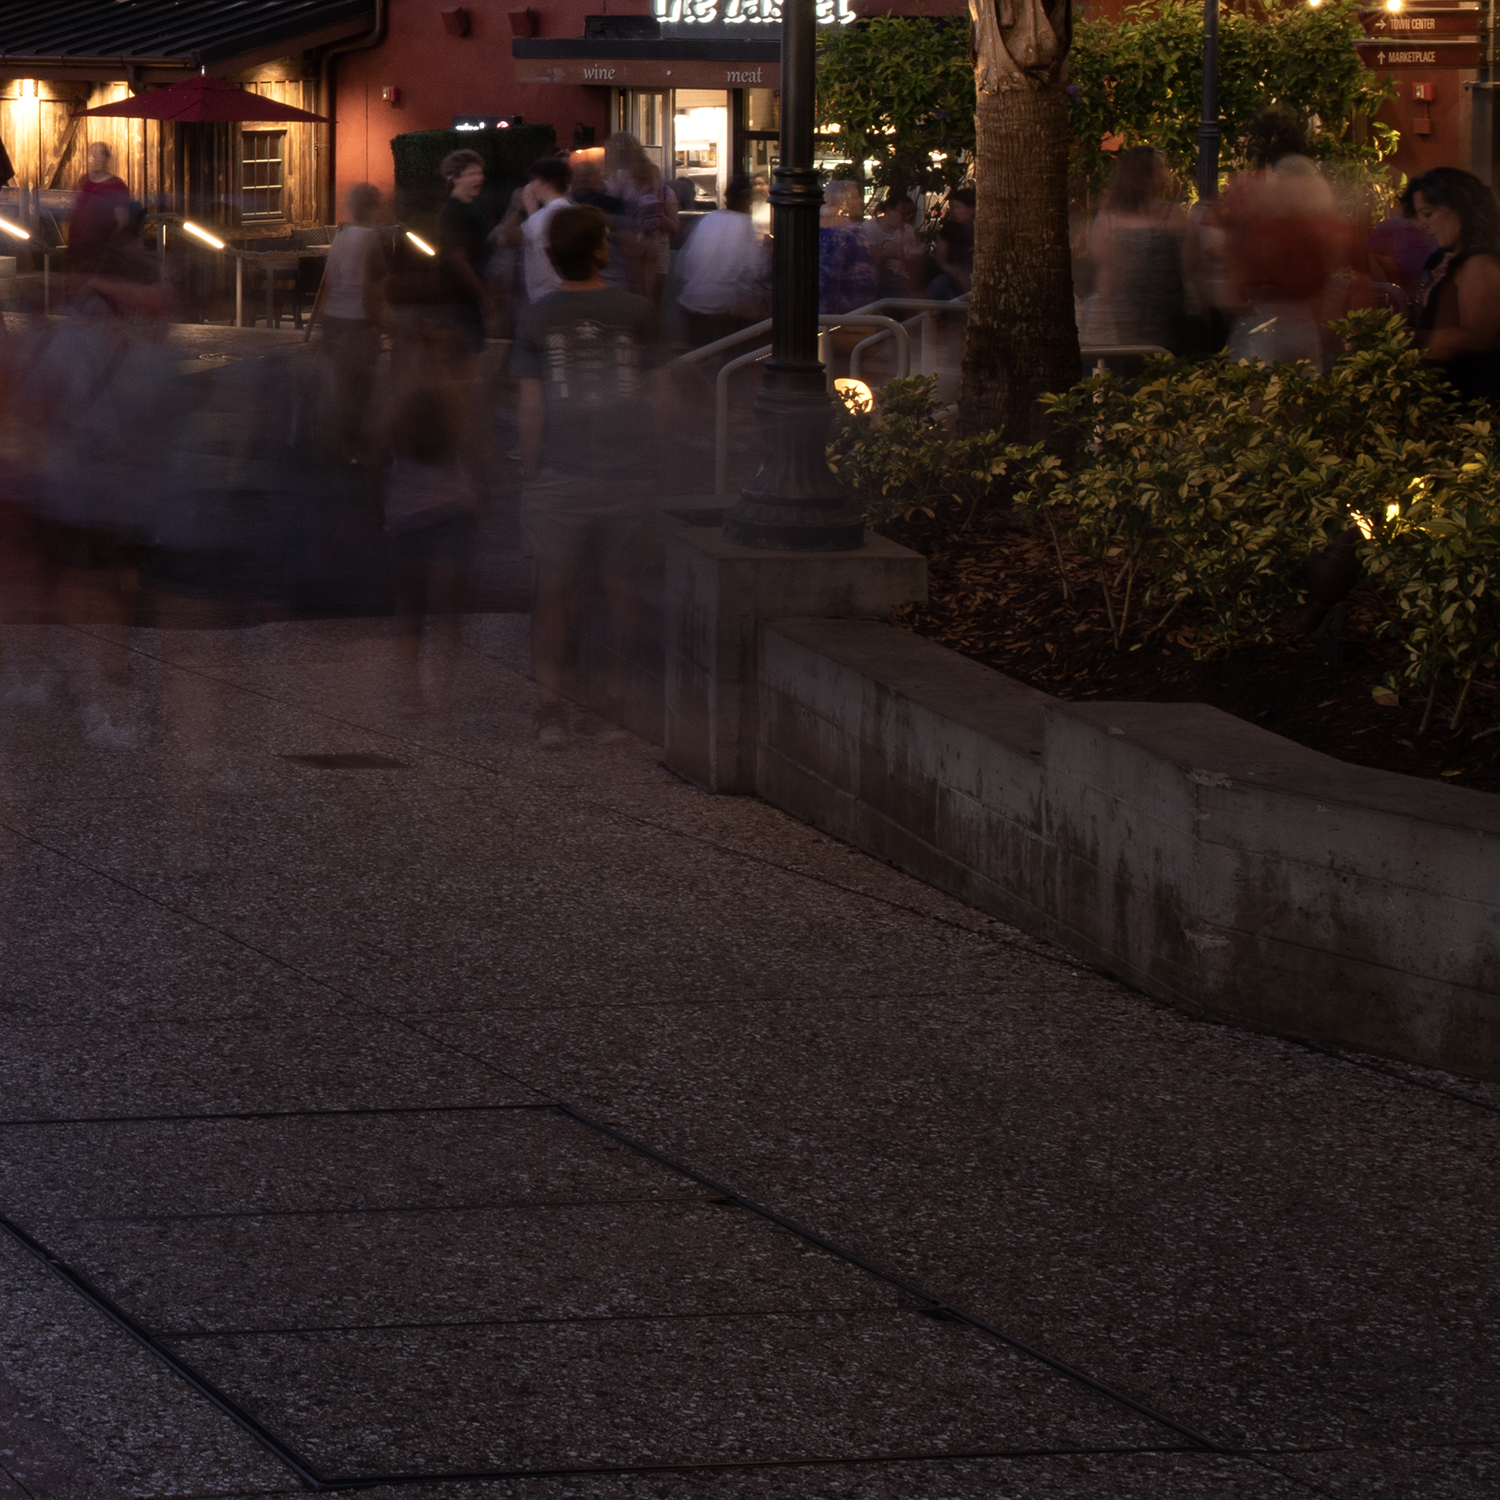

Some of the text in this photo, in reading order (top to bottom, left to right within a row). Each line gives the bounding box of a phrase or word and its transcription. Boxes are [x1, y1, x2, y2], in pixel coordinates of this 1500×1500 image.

[1389, 17, 1435, 30] TOWN CENTER
[1388, 50, 1436, 63] MARKETPLACE
[582, 63, 616, 81] wine
[726, 65, 763, 84] meat
